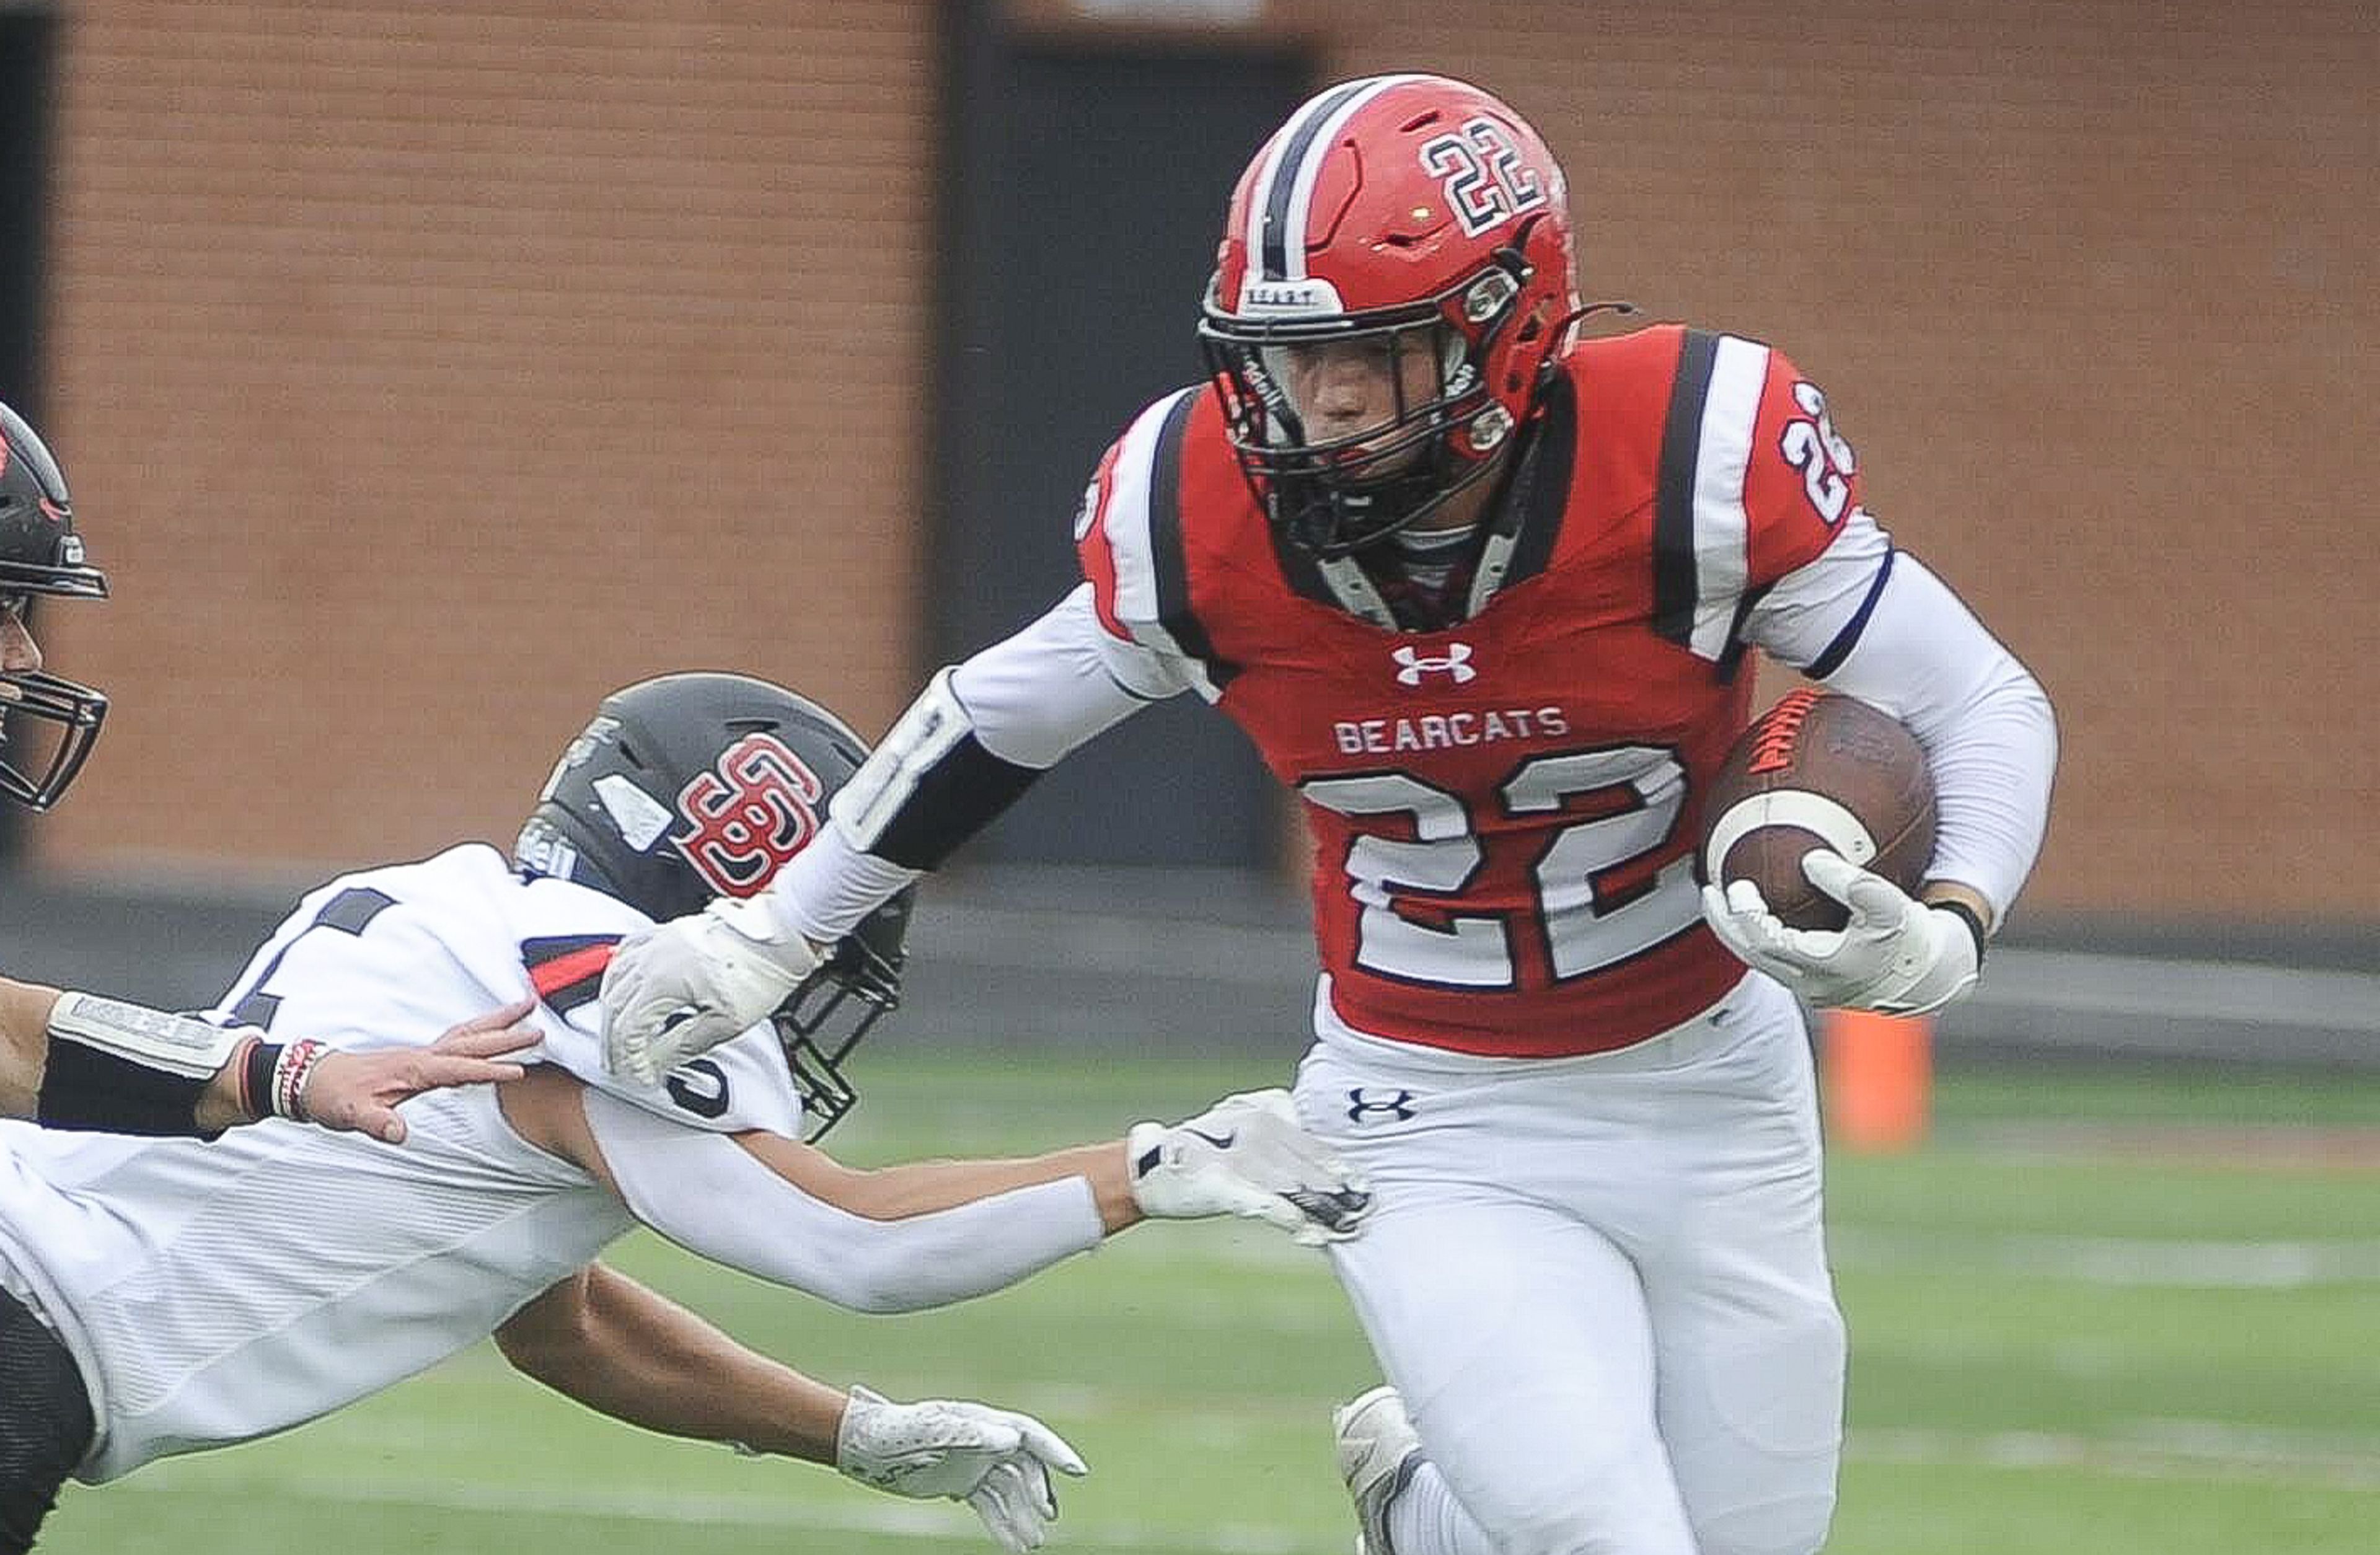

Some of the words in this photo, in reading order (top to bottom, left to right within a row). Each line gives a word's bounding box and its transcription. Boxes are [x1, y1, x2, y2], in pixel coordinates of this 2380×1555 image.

[1419, 117, 1547, 237] 22
[1780, 381, 1856, 525] 22
[1334, 707, 1569, 754] BEARCATS
[1297, 744, 1706, 991] 22
